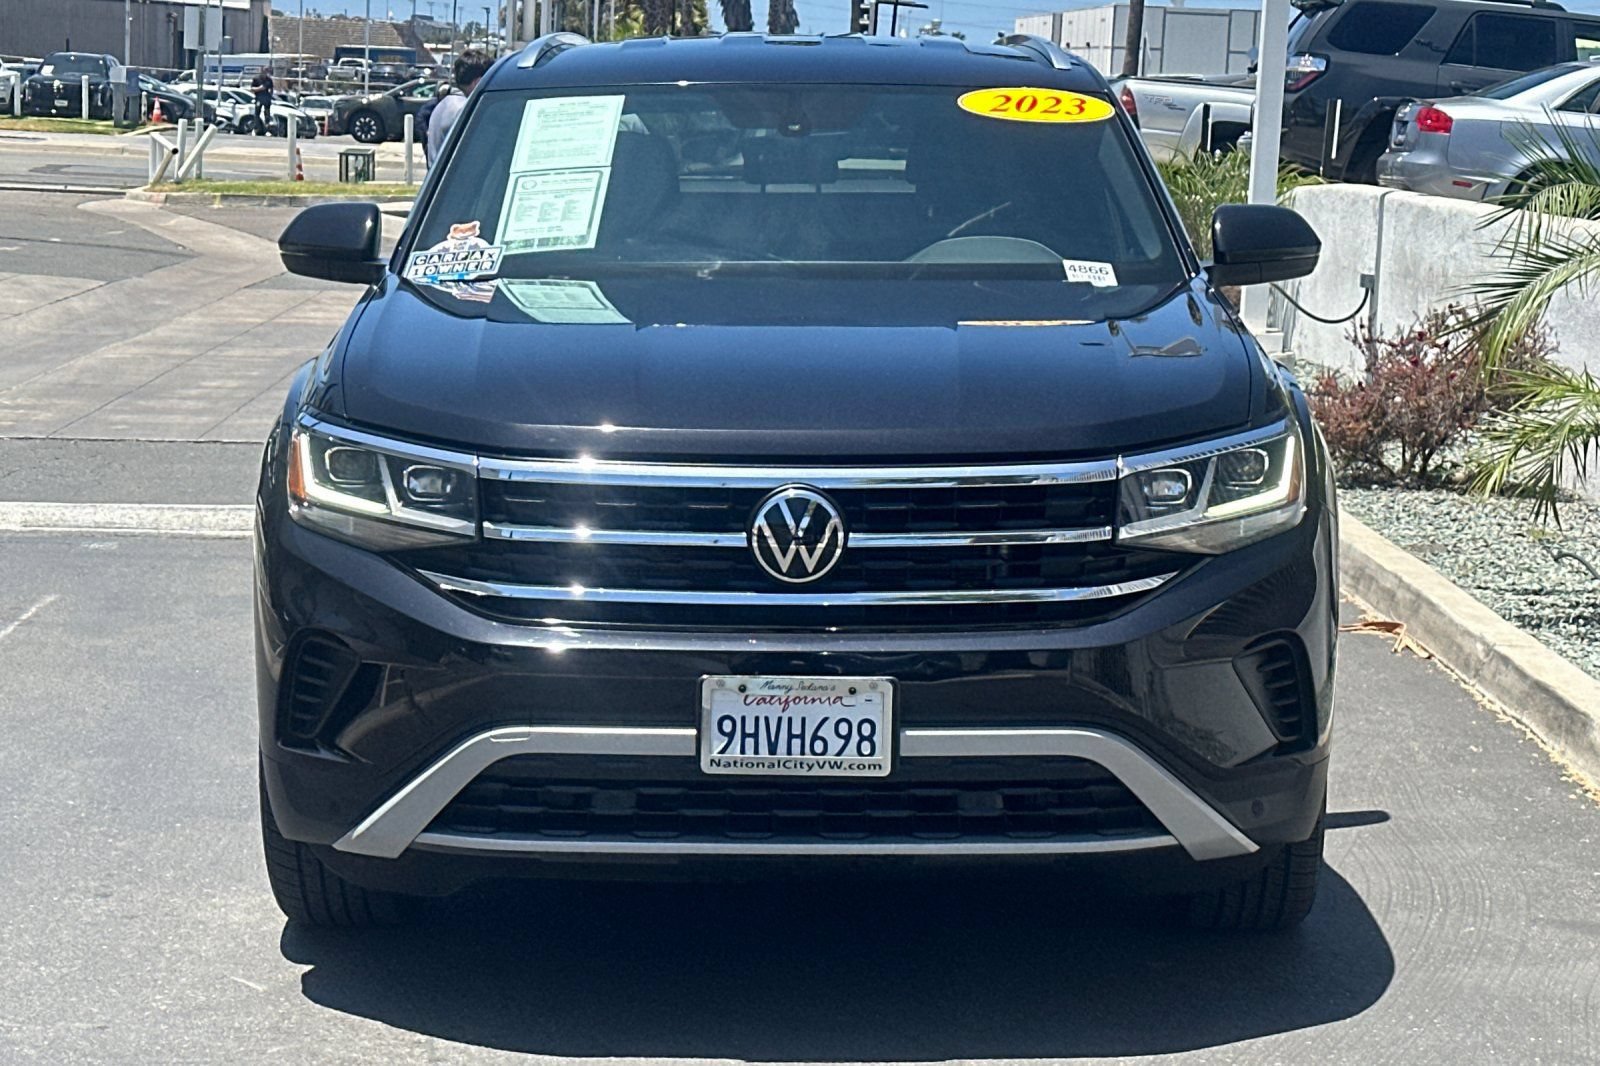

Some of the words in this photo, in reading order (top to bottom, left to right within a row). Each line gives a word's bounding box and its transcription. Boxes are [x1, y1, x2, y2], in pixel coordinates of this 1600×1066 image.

[989, 95, 1087, 115] 2023
[413, 251, 497, 266] CARFAX
[425, 260, 494, 276] OWNER
[1068, 264, 1109, 276] 4866
[716, 714, 877, 757] 9HVH698
[709, 758, 882, 772] NationalCityVW.com
